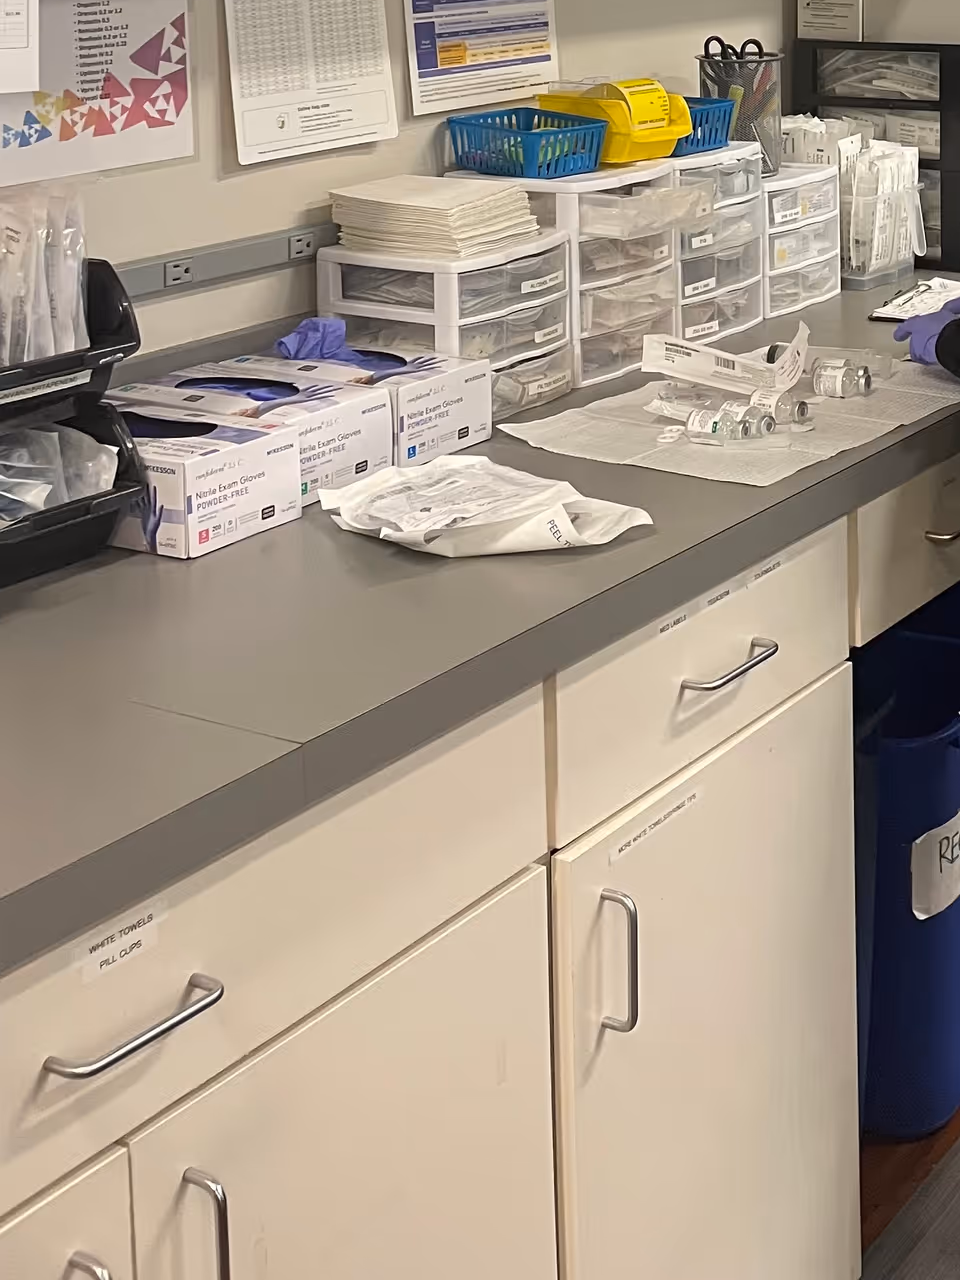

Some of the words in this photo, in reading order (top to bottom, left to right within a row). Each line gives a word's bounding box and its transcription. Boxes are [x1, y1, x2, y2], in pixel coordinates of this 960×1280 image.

[407, 409, 424, 421] Nitrile
[425, 403, 442, 415] Exam
[442, 396, 464, 409] Gloves
[407, 409, 450, 430] POWDER-FREE
[317, 437, 337, 449] Exam
[337, 428, 361, 442] Gloves
[196, 487, 217, 501] Nitrile
[218, 479, 239, 494] Exam
[239, 471, 266, 486] Gloves
[196, 486, 250, 511] POWDER-FREE
[546, 518, 563, 544] PEEL
[659, 623, 670, 634] MED
[670, 614, 687, 629] LABELS
[618, 839, 632, 854] MORE
[632, 827, 648, 842] WHITE
[88, 933, 116, 955] WHITE
[118, 913, 153, 938] TOWELS
[99, 954, 117, 970] PILL
[119, 938, 143, 959] CUPS
